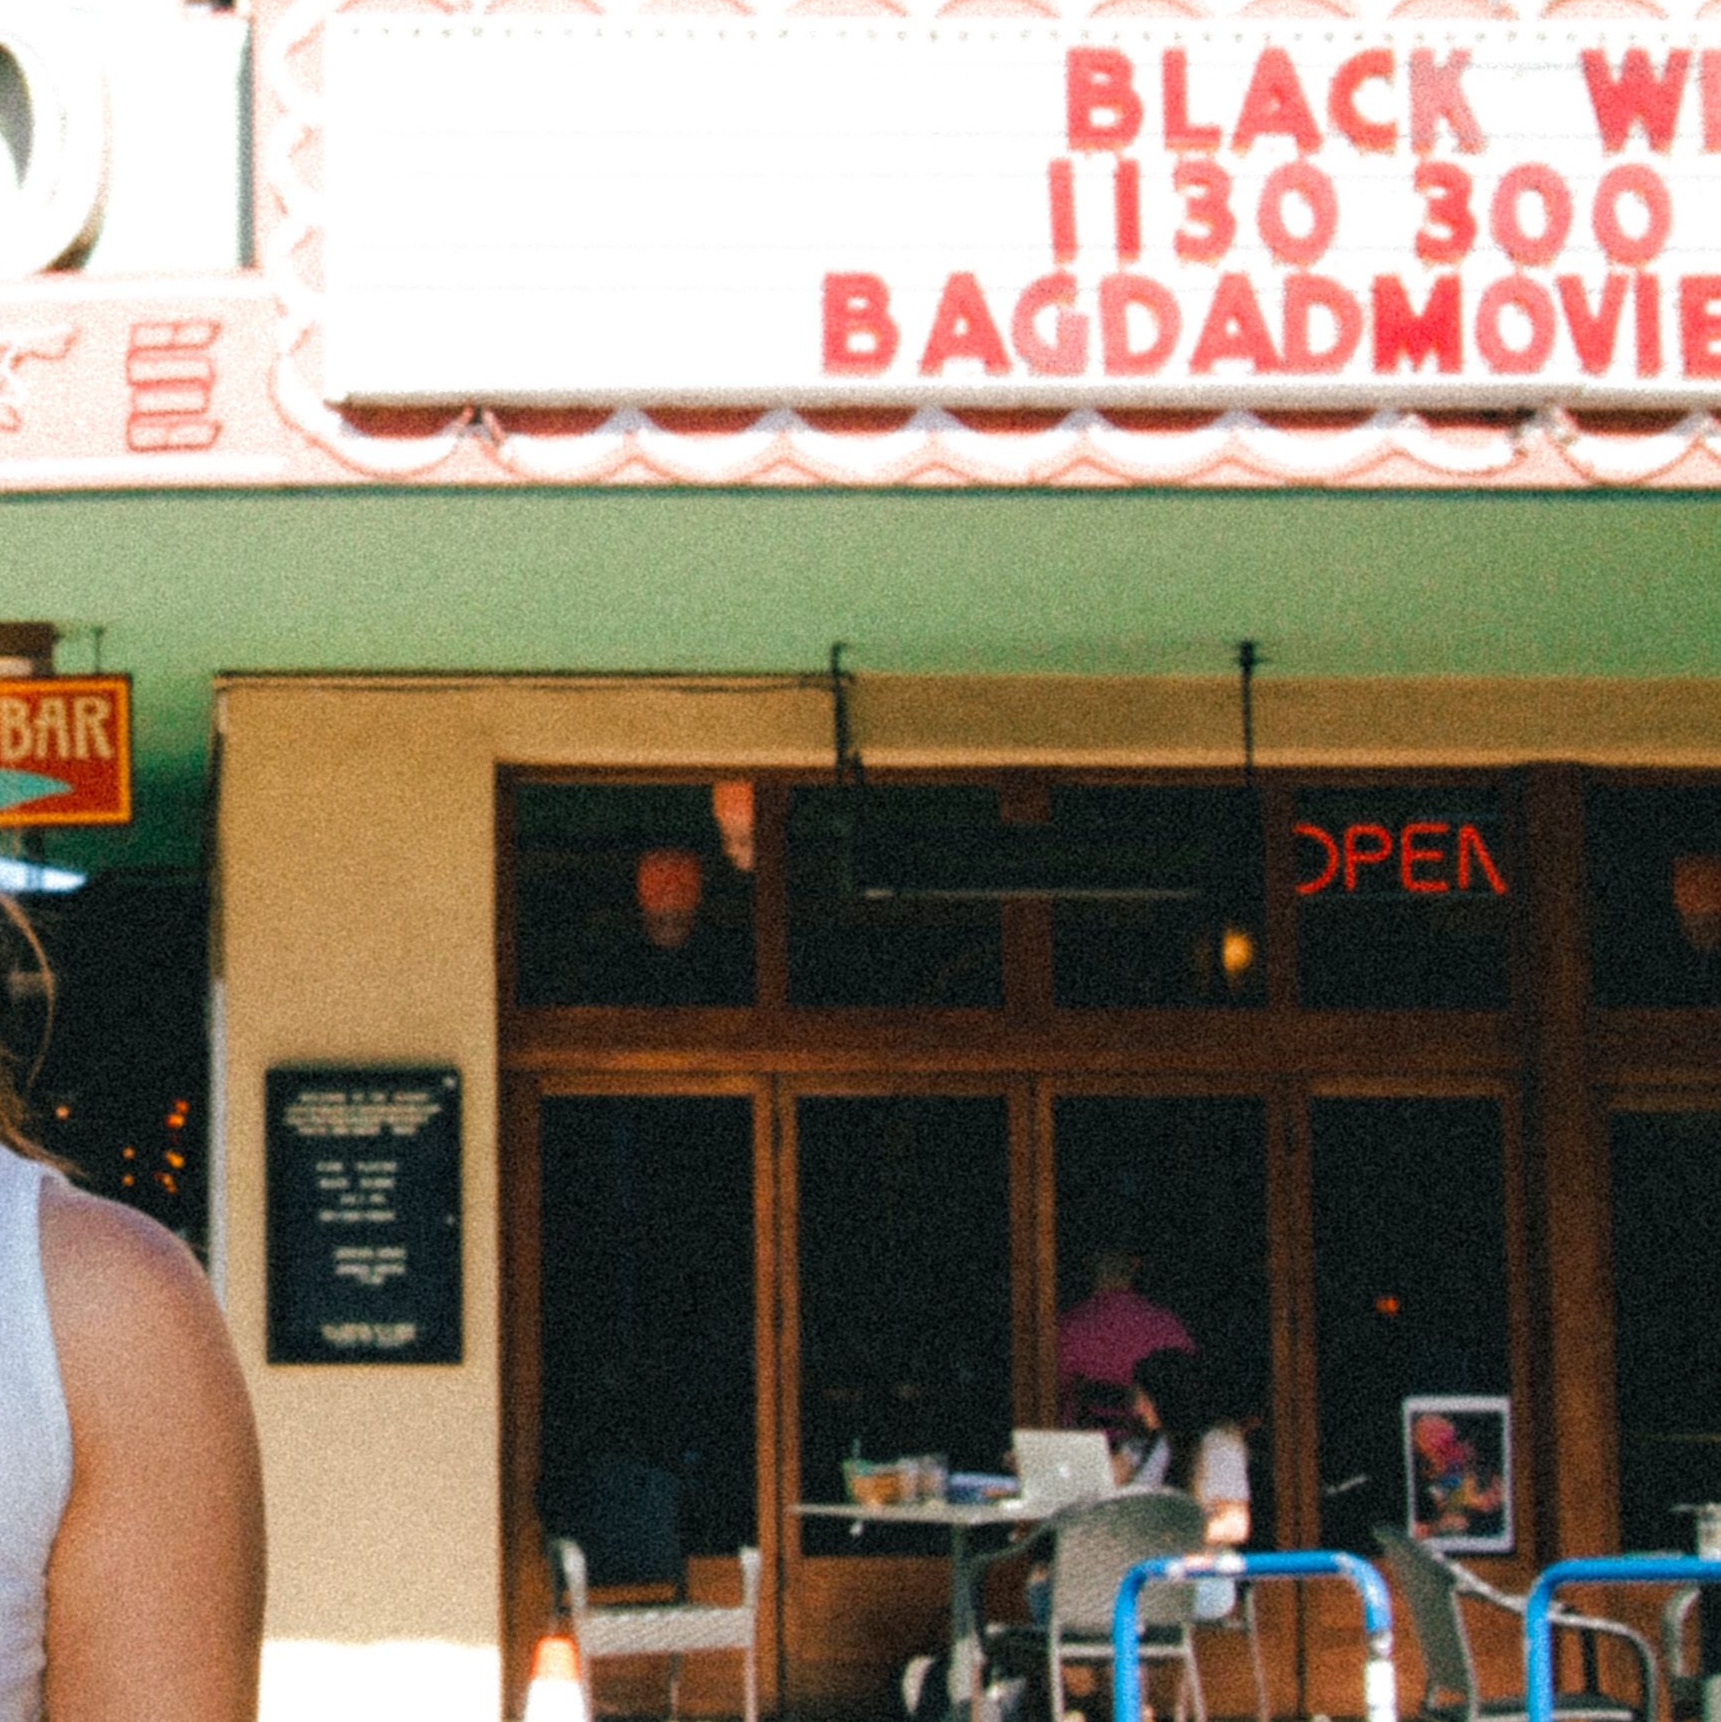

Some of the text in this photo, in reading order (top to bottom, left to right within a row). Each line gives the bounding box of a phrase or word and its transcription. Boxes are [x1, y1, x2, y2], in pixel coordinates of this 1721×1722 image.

[1064, 47, 1488, 154] BLACK
[1047, 158, 1673, 266] 1130 300
